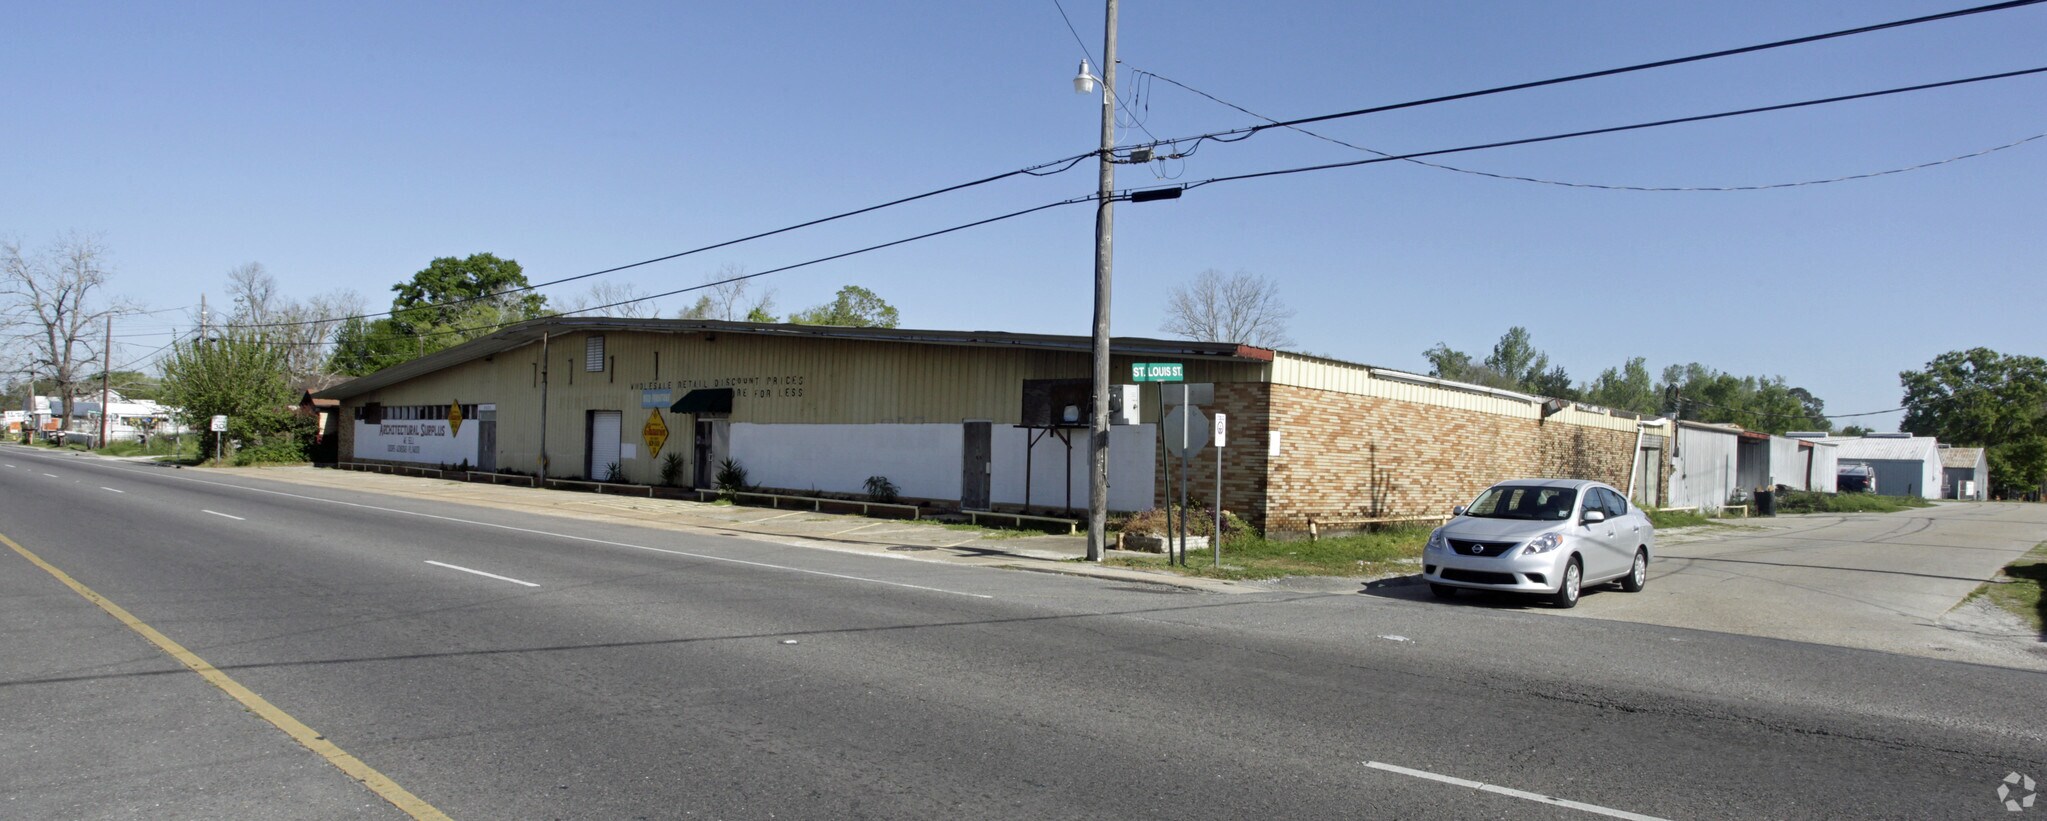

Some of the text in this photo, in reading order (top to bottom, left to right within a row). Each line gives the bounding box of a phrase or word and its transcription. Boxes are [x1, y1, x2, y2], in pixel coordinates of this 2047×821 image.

[1133, 366, 1183, 377] ST. LOUIS ST.
[630, 375, 804, 390] WHOLESALE RETAIL DISCOUNT PRICES
[754, 389, 771, 398] FOR
[778, 387, 803, 398] LESS
[379, 424, 446, 437] ARCHITECTURAL SURPLUS
